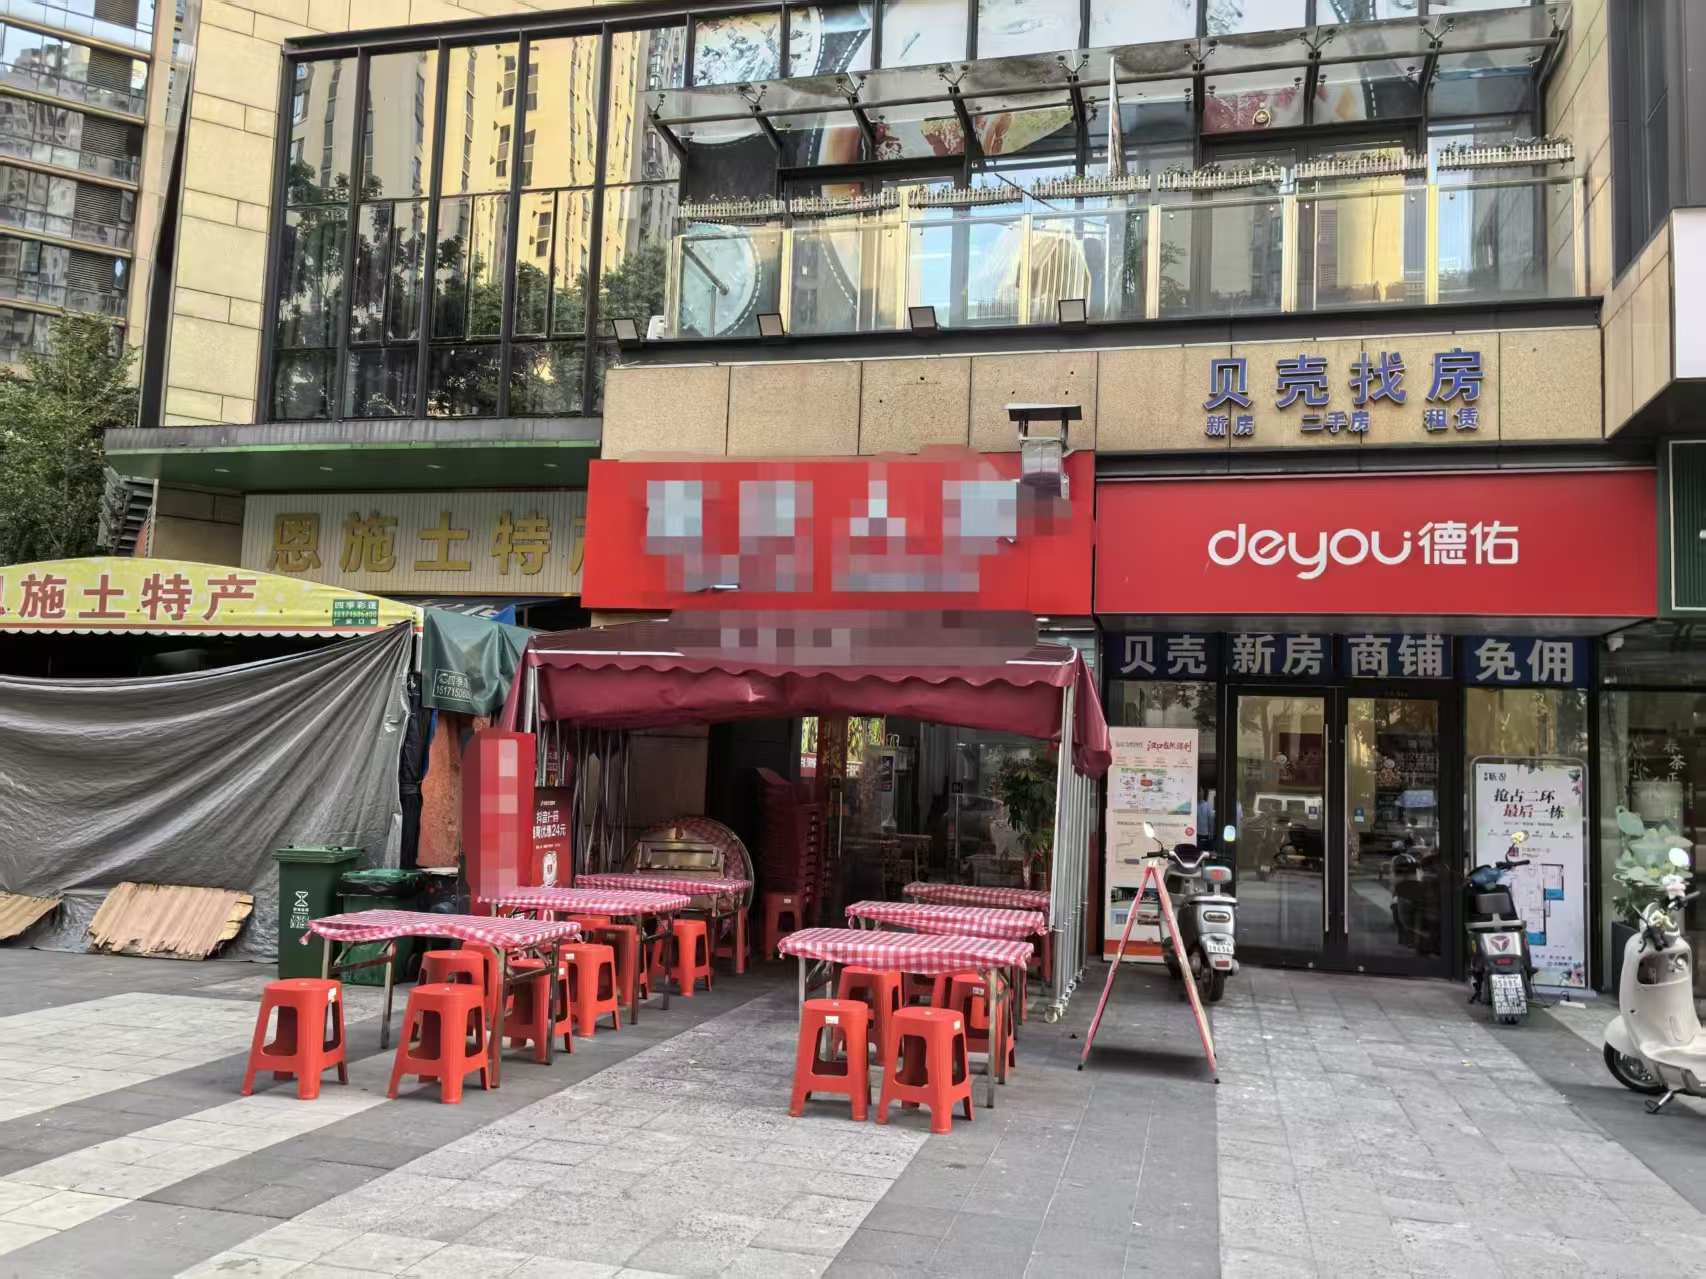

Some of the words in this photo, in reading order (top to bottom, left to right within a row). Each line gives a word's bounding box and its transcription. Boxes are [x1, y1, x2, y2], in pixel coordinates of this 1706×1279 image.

[1203, 348, 1484, 409] 贝壳找房
[1205, 414, 1255, 437] 新房
[1301, 410, 1370, 433] 二手房
[1425, 407, 1479, 431] 租赁
[267, 510, 584, 575] 恩施土特
[0, 573, 257, 621] 施土特产
[1120, 634, 1207, 674] 贝壳
[1232, 633, 1323, 676] 新房
[1348, 633, 1444, 677] 商铺
[1474, 638, 1574, 683] 免佣
[1494, 788, 1556, 804] 抢占二环
[1503, 803, 1565, 819] 最后一栋
